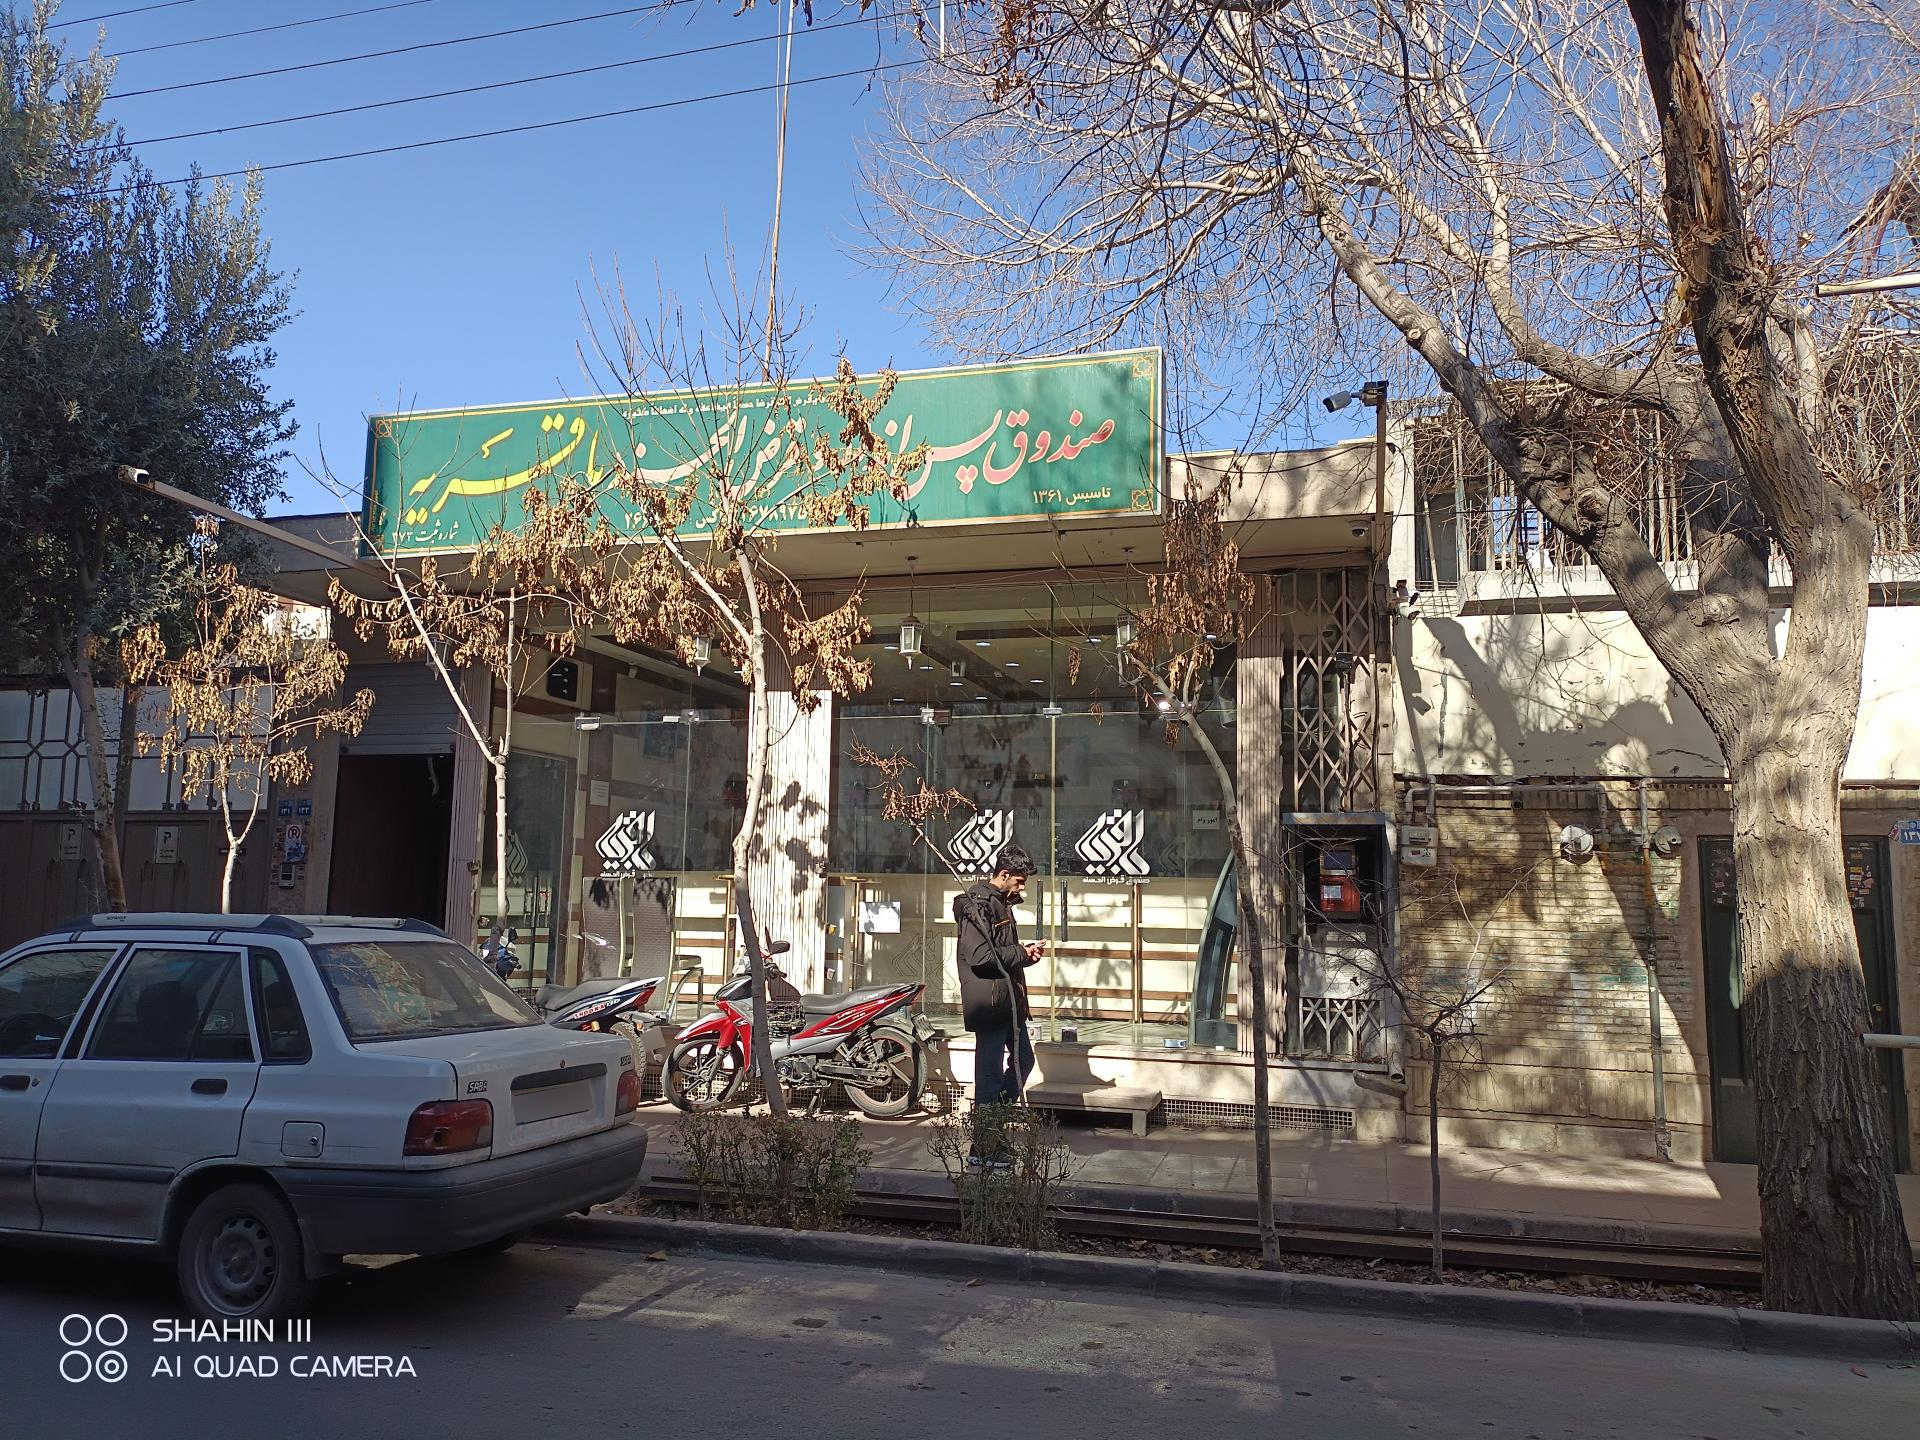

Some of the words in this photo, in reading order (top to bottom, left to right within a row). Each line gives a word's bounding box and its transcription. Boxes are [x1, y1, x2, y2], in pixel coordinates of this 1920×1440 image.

[983, 407, 1116, 486] صندوق
[1032, 488, 1063, 504] ۱۳۶۱
[1065, 486, 1112, 507] تاسیس
[415, 518, 442, 544] ثبت
[438, 520, 460, 542] شماره
[1082, 875, 1106, 884] الحسنه
[1106, 874, 1125, 886] قرض
[1125, 875, 1150, 886] صندوق
[467, 1080, 489, 1094] SABA
